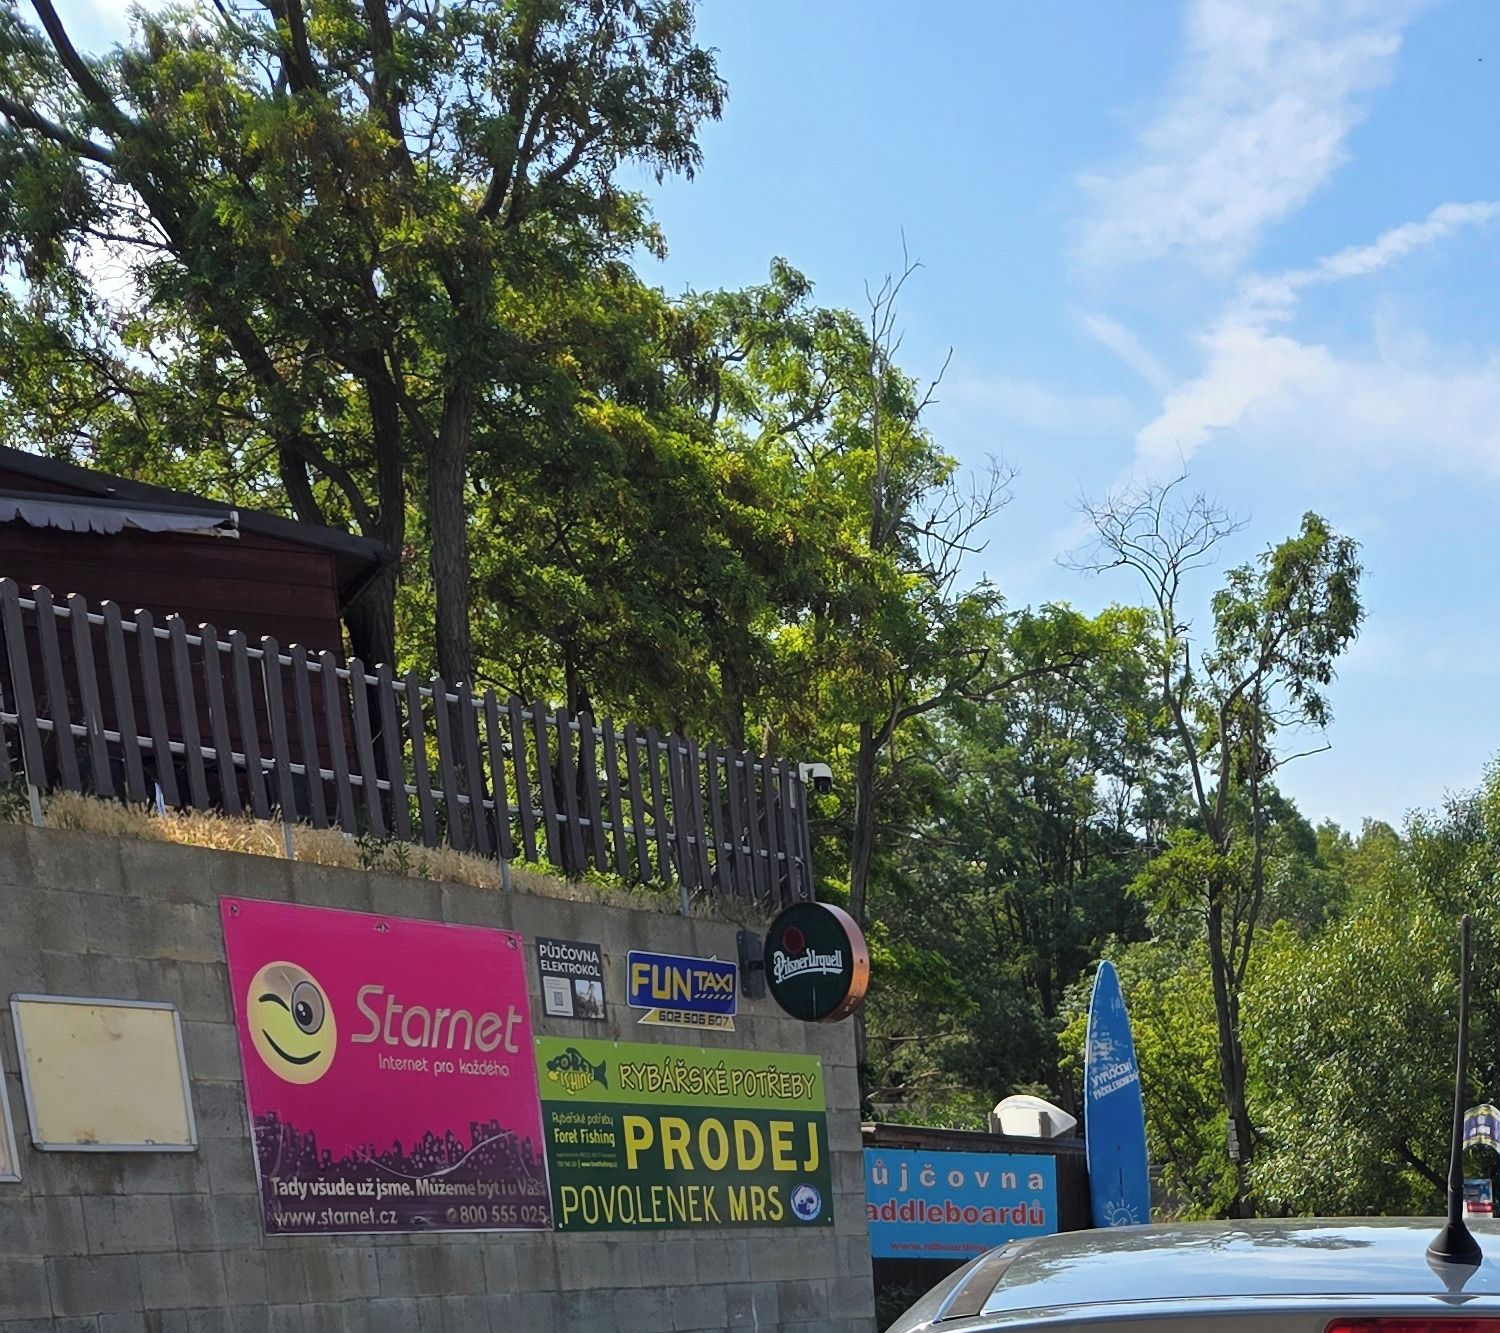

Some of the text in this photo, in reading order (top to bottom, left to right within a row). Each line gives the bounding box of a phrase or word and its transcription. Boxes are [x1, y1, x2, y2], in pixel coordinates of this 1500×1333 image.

[539, 941, 600, 963] PŮJČOVNA
[540, 959, 601, 977] ELEKTROKOL
[773, 947, 843, 984] Pilsner Urquell
[632, 962, 733, 1002] FUN TAXI
[351, 984, 523, 1054] Starnet
[659, 1010, 682, 1023] 602
[708, 1015, 730, 1026] 607
[378, 1053, 510, 1077] Internet pro každého
[619, 1056, 815, 1099] RYBÁŘSKÉ POTŘEBY
[551, 1112, 614, 1127] Rybářské potřeby
[554, 1128, 616, 1148] Foret Fishing
[622, 1115, 820, 1172] PRODEJ
[871, 1159, 1044, 1192] ůjčovna
[271, 1177, 307, 1200] Tady
[309, 1178, 355, 1197] všude
[357, 1178, 375, 1196] už
[375, 1181, 415, 1200] jsme.
[416, 1178, 475, 1196] Můžeme
[478, 1178, 501, 1200] být
[507, 1183, 517, 1195] u
[274, 1206, 398, 1227] www.starnet.cz
[459, 1205, 546, 1223] 800 555 025
[560, 1184, 722, 1225] POVOLENEK
[727, 1185, 784, 1222] MRS
[866, 1199, 1047, 1226] addleboardů
